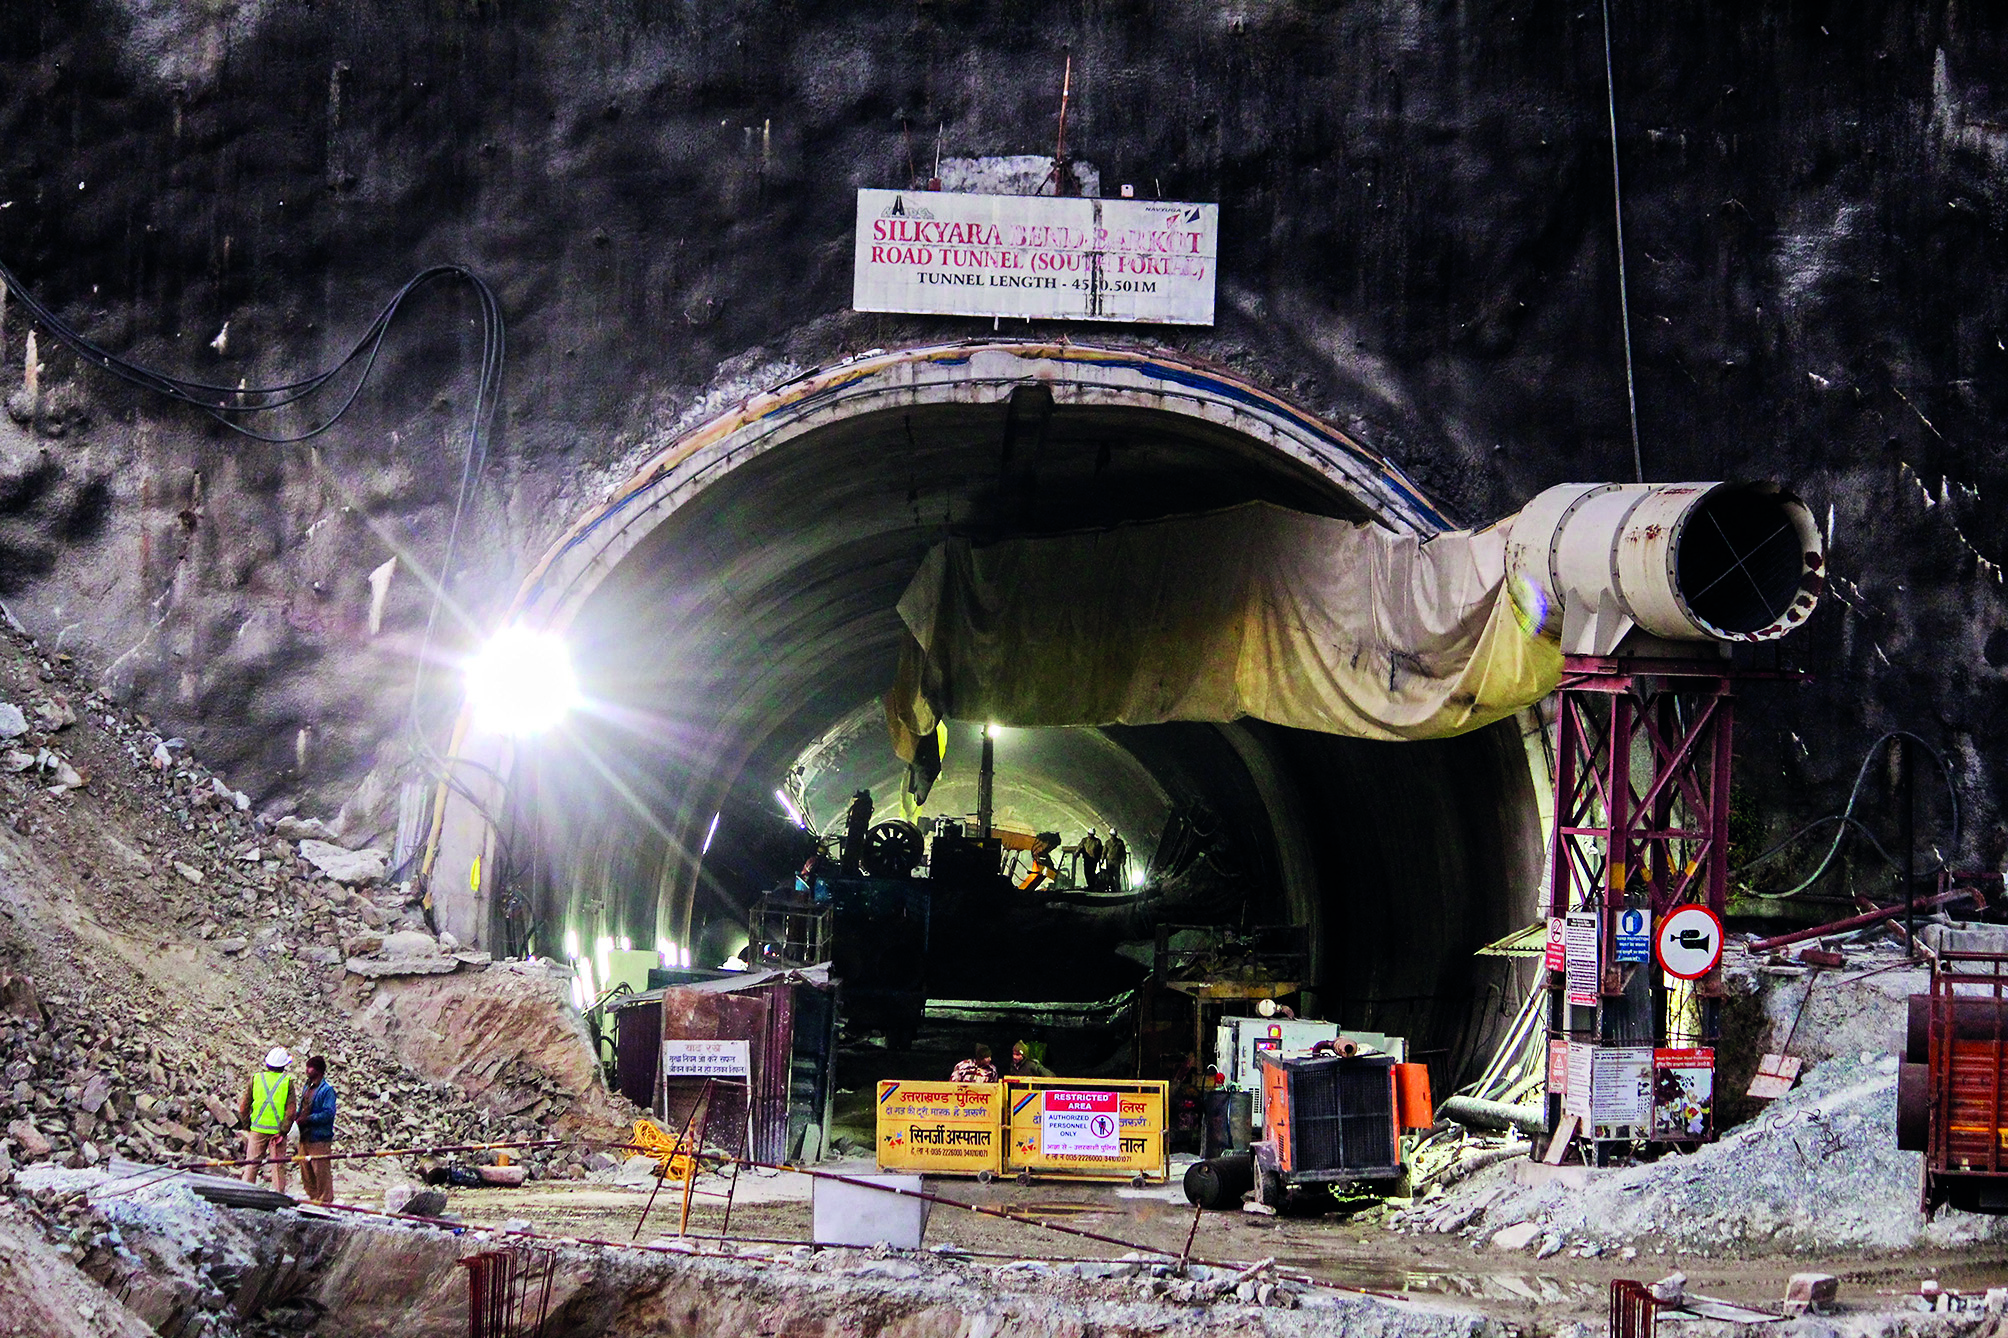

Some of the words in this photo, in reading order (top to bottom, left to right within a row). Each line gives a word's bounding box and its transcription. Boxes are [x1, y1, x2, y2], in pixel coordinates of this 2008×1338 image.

[873, 219, 1002, 246] SILKYARA
[871, 246, 932, 266] ROAD
[939, 249, 1024, 269] TUNNEL
[917, 272, 985, 287] TUNNEL
[990, 275, 1057, 290] LENGTH
[900, 1091, 953, 1104] उत्तराखण्ड
[955, 1090, 991, 1107] पुलिस
[1054, 1094, 1109, 1102] RESTRICTED
[909, 1125, 945, 1144] सिनर्जी
[945, 1130, 992, 1146] अस्पताल
[1101, 1143, 1117, 1153] पुलिस
